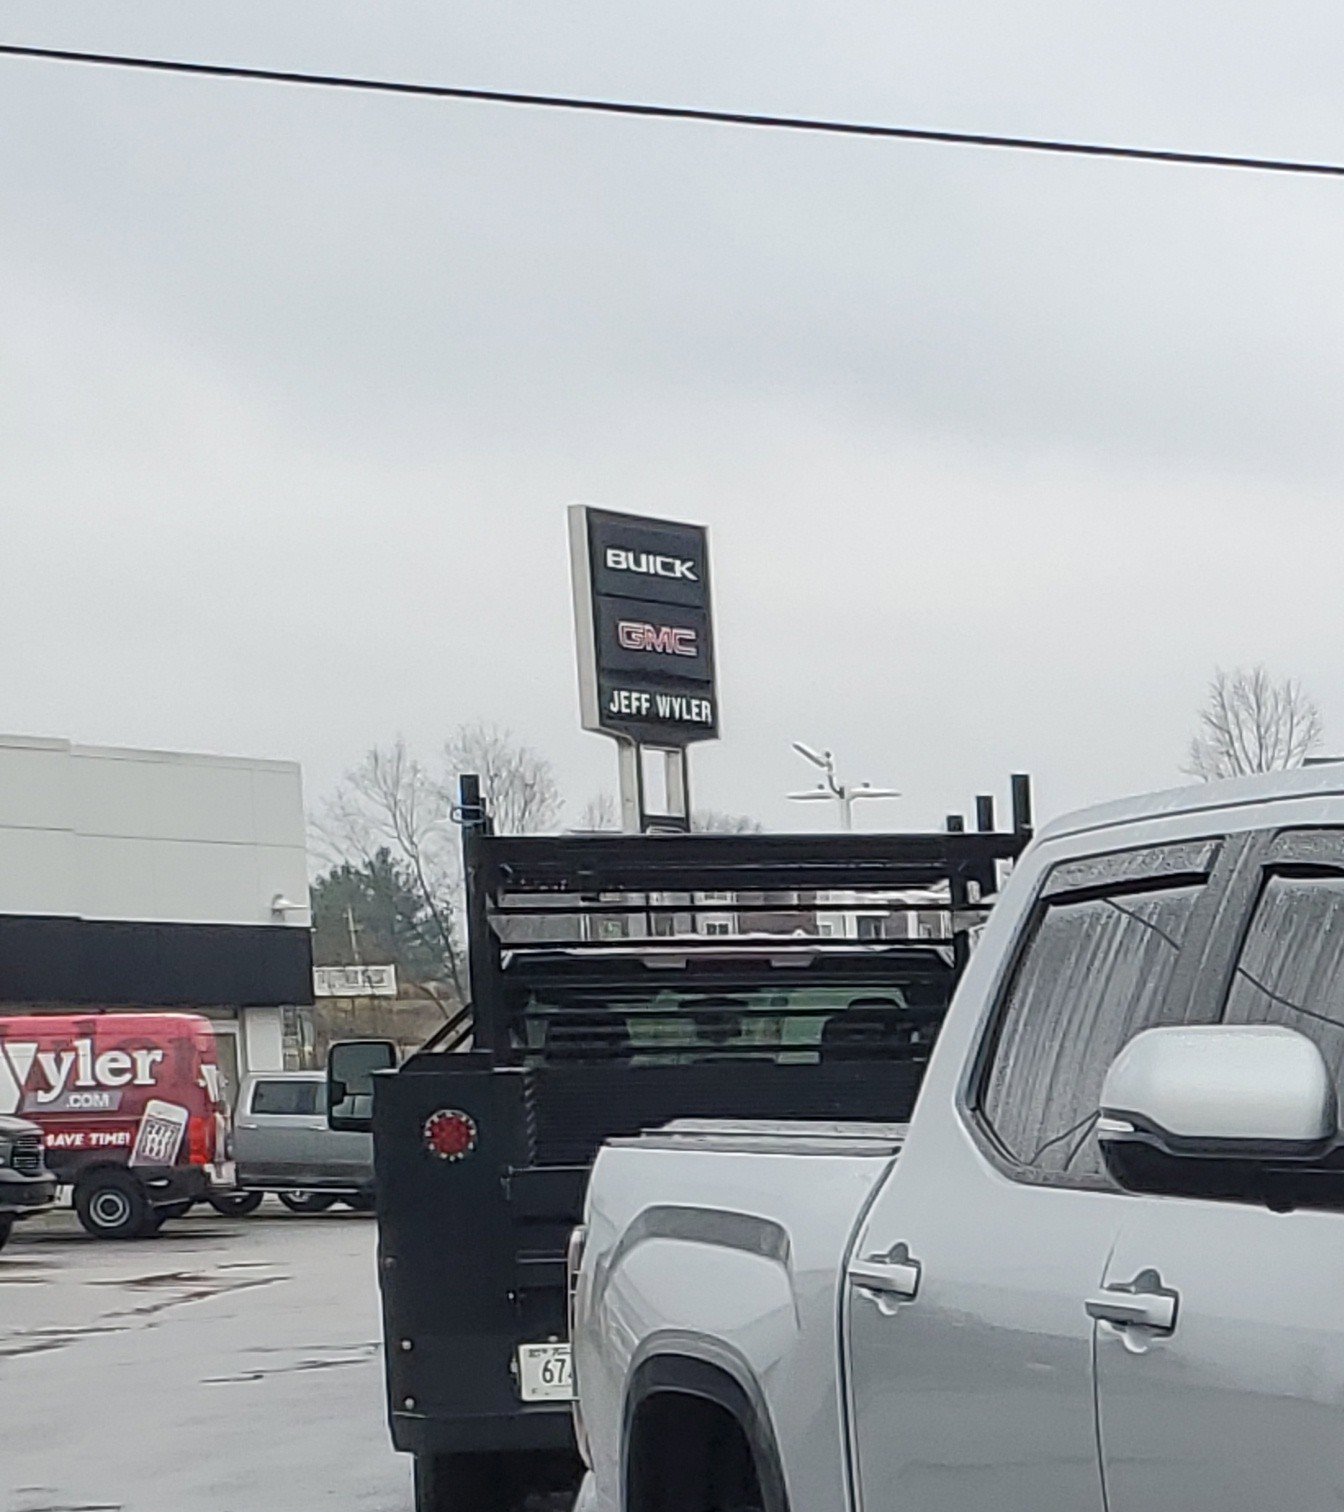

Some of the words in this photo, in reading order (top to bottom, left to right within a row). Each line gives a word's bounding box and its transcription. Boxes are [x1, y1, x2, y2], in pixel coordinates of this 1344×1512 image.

[606, 548, 698, 581] BUICK
[618, 620, 698, 656] GMC
[609, 690, 650, 714] JEFF
[656, 694, 713, 725] WYLER
[541, 1358, 572, 1384] 67
